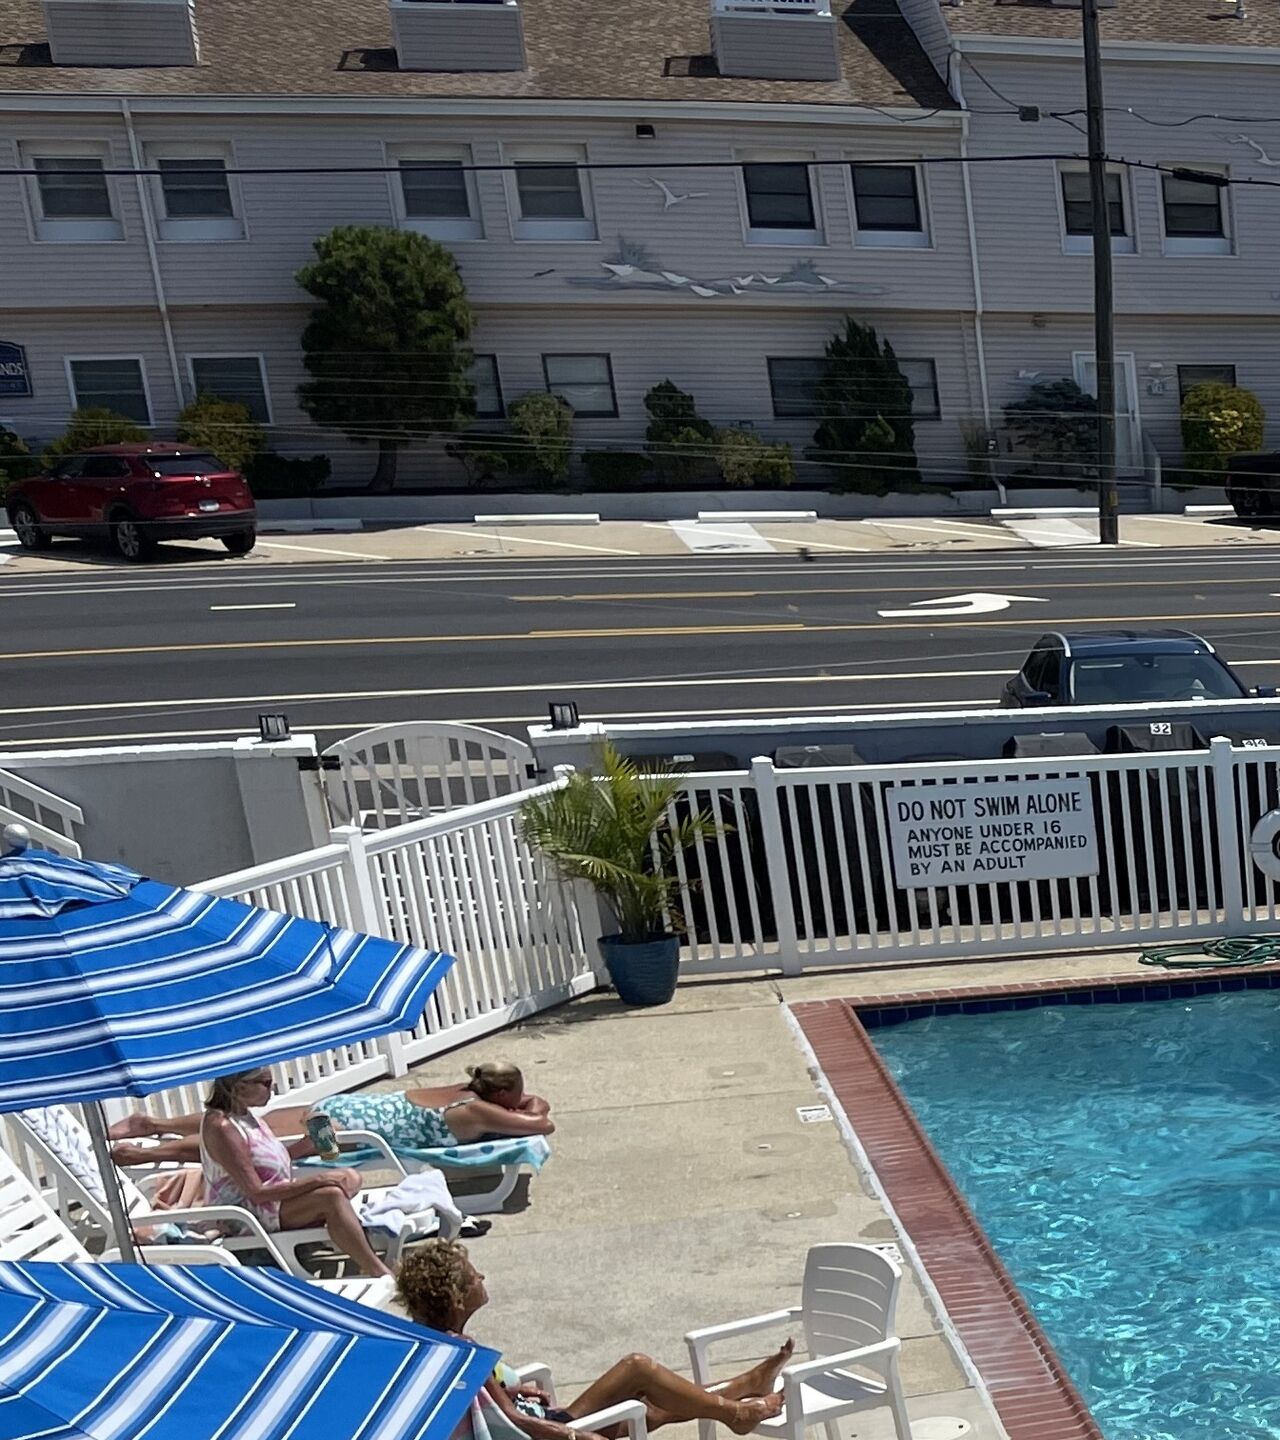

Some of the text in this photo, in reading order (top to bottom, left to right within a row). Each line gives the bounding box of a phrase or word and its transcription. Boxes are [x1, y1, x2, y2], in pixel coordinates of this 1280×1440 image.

[1152, 724, 1170, 734] 32
[897, 791, 1082, 822] DO NOT SWIM ALONE
[907, 820, 1062, 844] ANYONE UNDER 16
[908, 834, 1088, 860] MUST BE ACCOMPANIED
[910, 855, 1026, 876] BY AN ADULT
